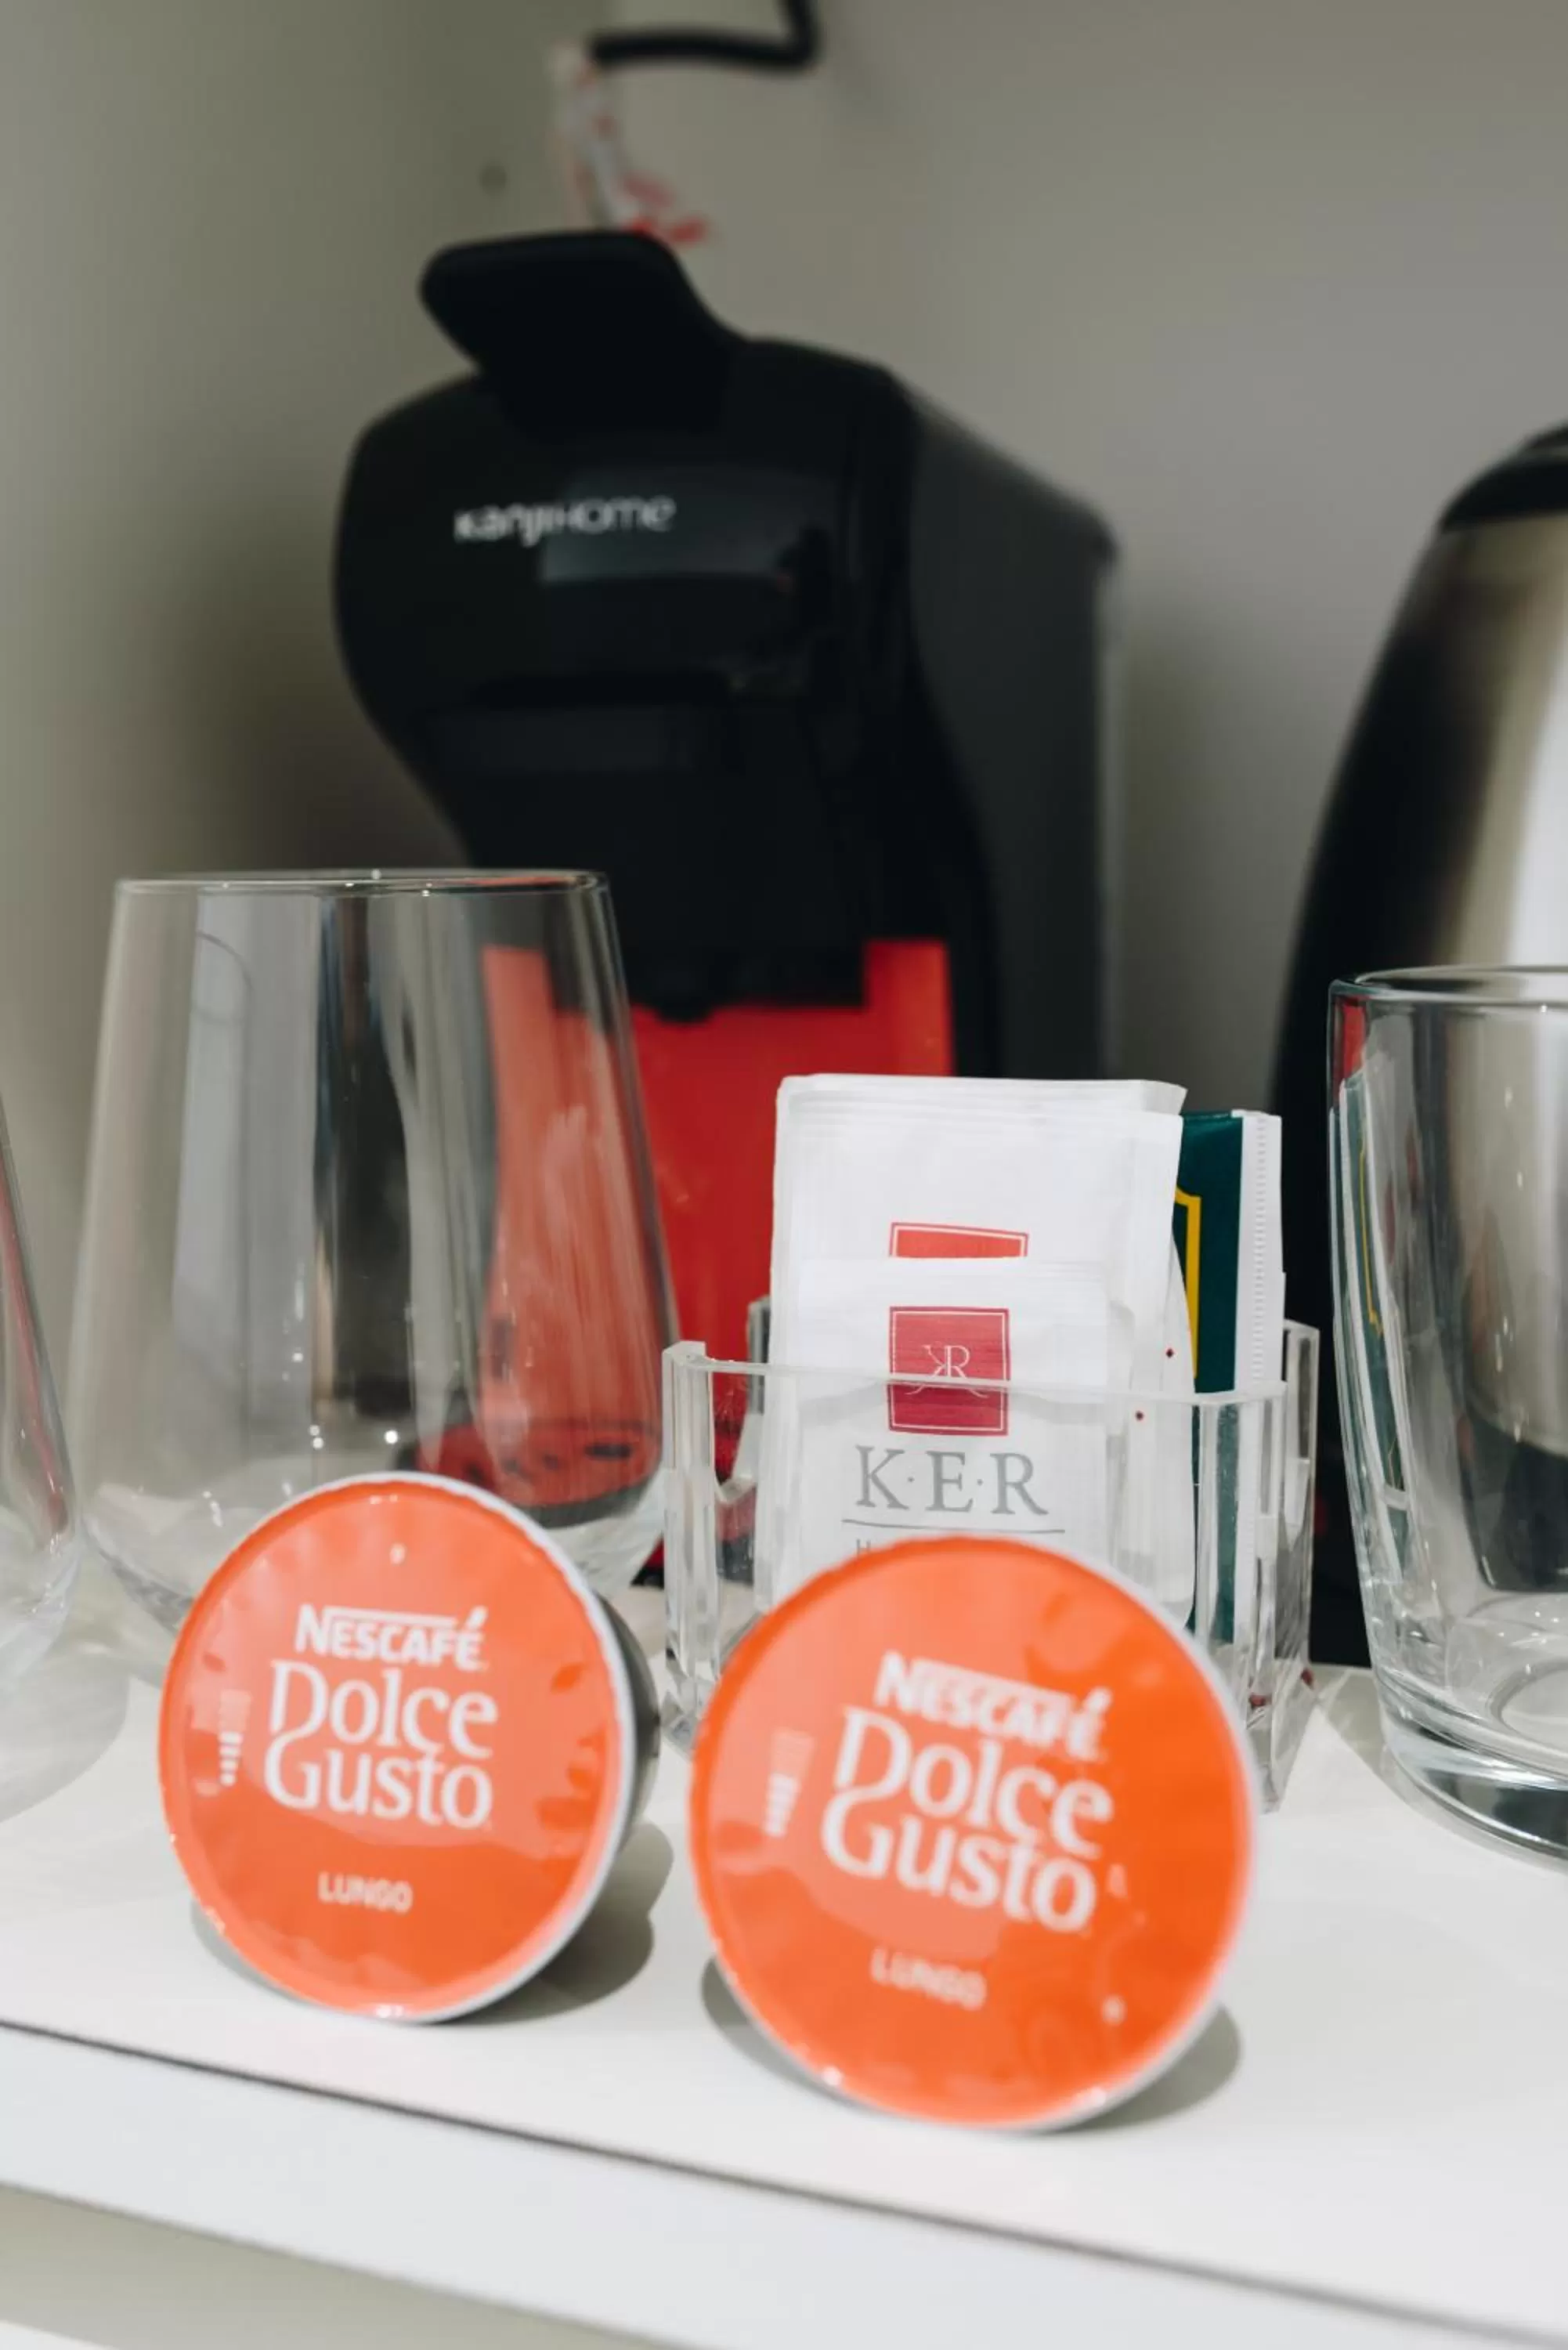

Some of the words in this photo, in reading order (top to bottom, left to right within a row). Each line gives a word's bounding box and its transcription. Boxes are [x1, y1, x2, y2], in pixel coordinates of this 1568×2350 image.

[269, 1658, 498, 1759] Dolce
[834, 1705, 1114, 1859] Dolce
[318, 1871, 413, 1914] LUNGO
